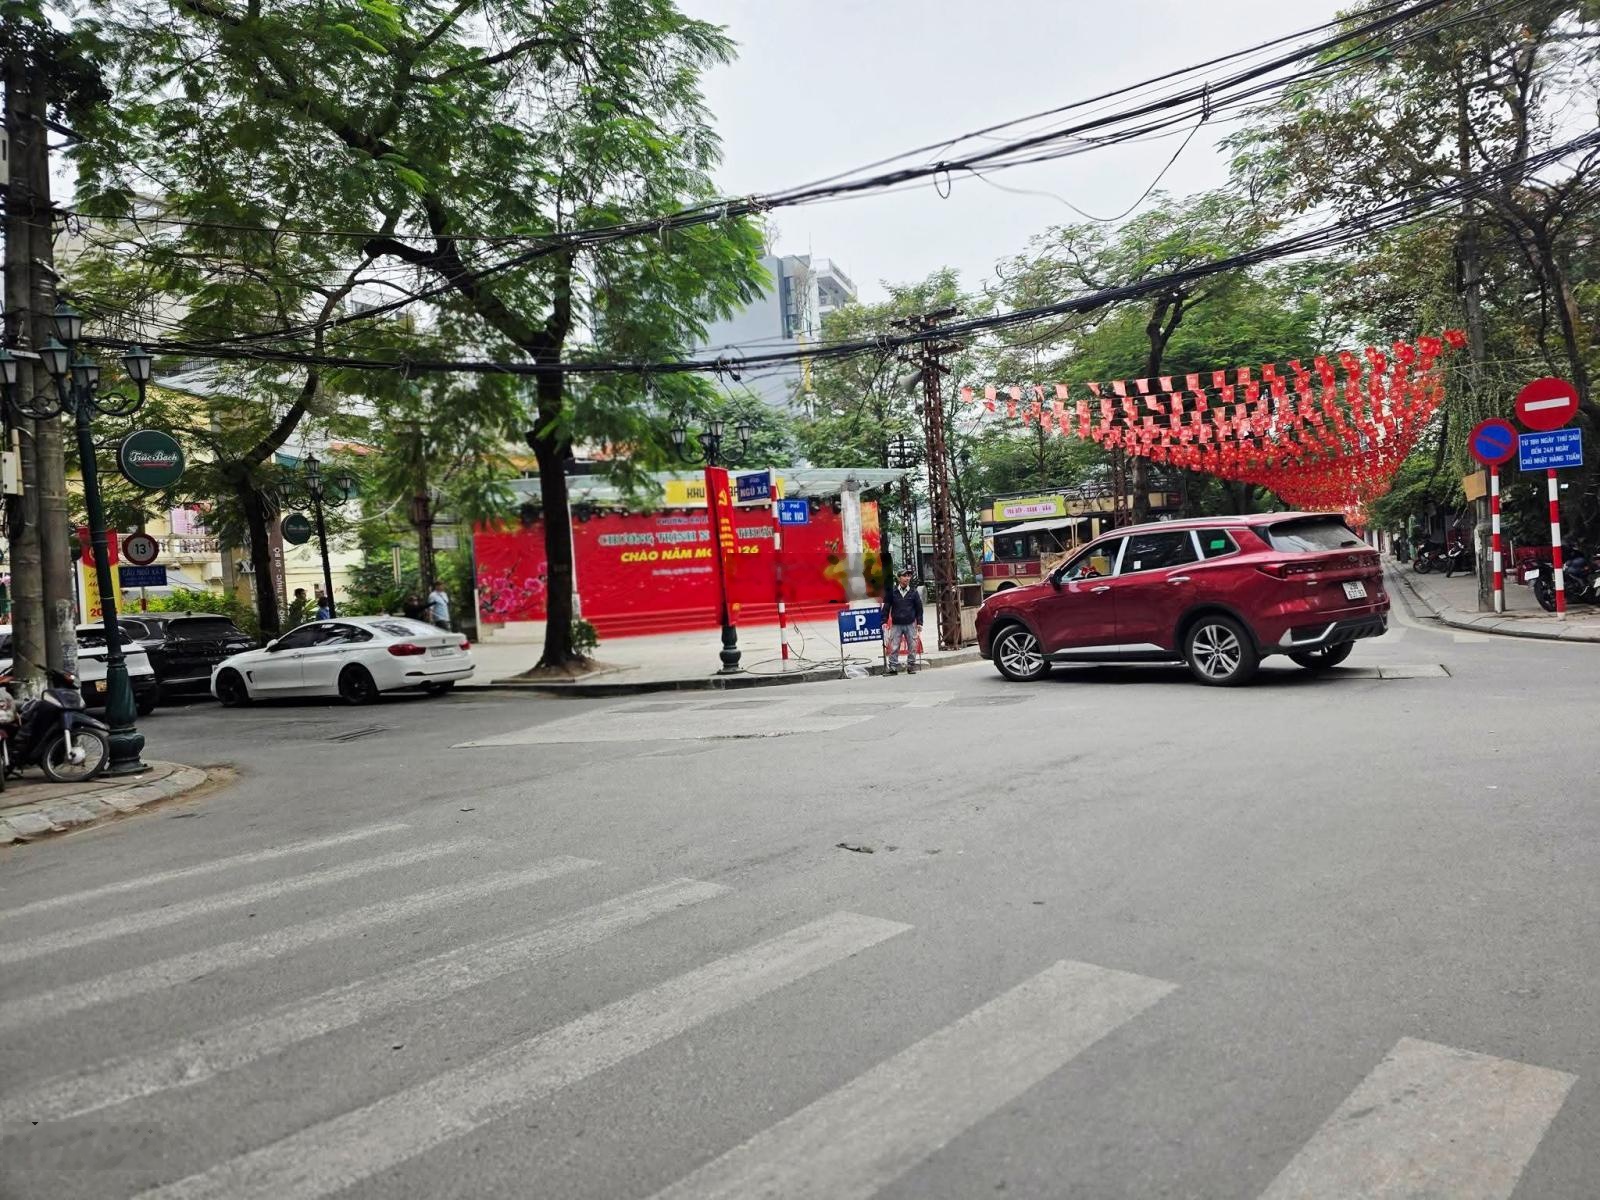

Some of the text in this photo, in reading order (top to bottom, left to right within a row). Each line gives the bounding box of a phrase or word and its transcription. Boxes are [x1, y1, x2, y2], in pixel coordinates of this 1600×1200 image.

[621, 549, 658, 562] CHÀO
[661, 547, 692, 560] NĂM
[855, 615, 867, 631] P
